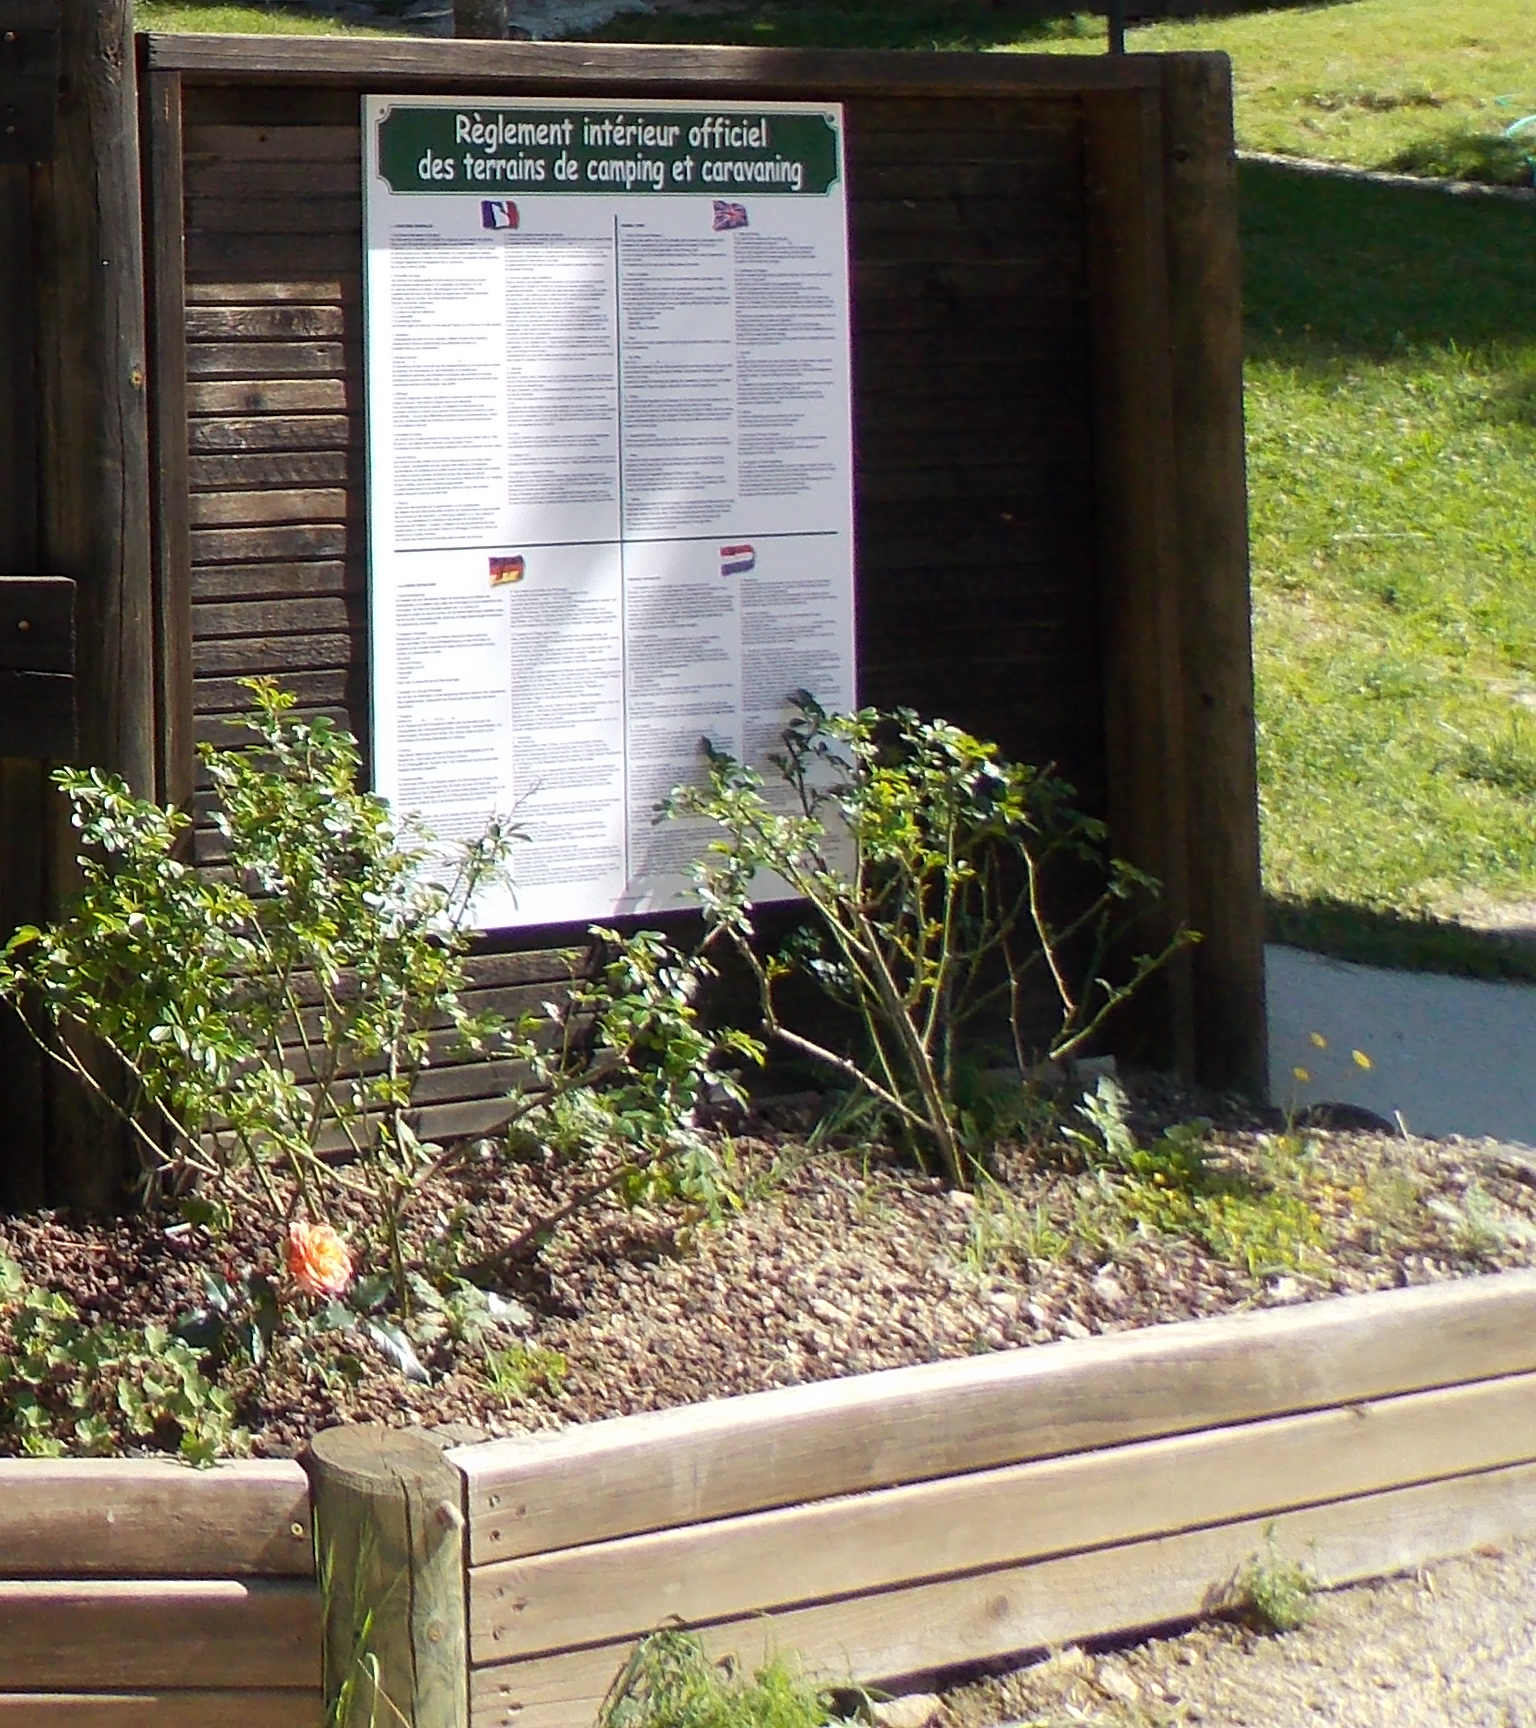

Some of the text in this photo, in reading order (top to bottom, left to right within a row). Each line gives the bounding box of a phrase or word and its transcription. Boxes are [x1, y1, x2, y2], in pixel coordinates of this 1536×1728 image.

[456, 113, 767, 154] Règlement intérieur officiel
[418, 150, 803, 191] des terrains de camping et caravaning
